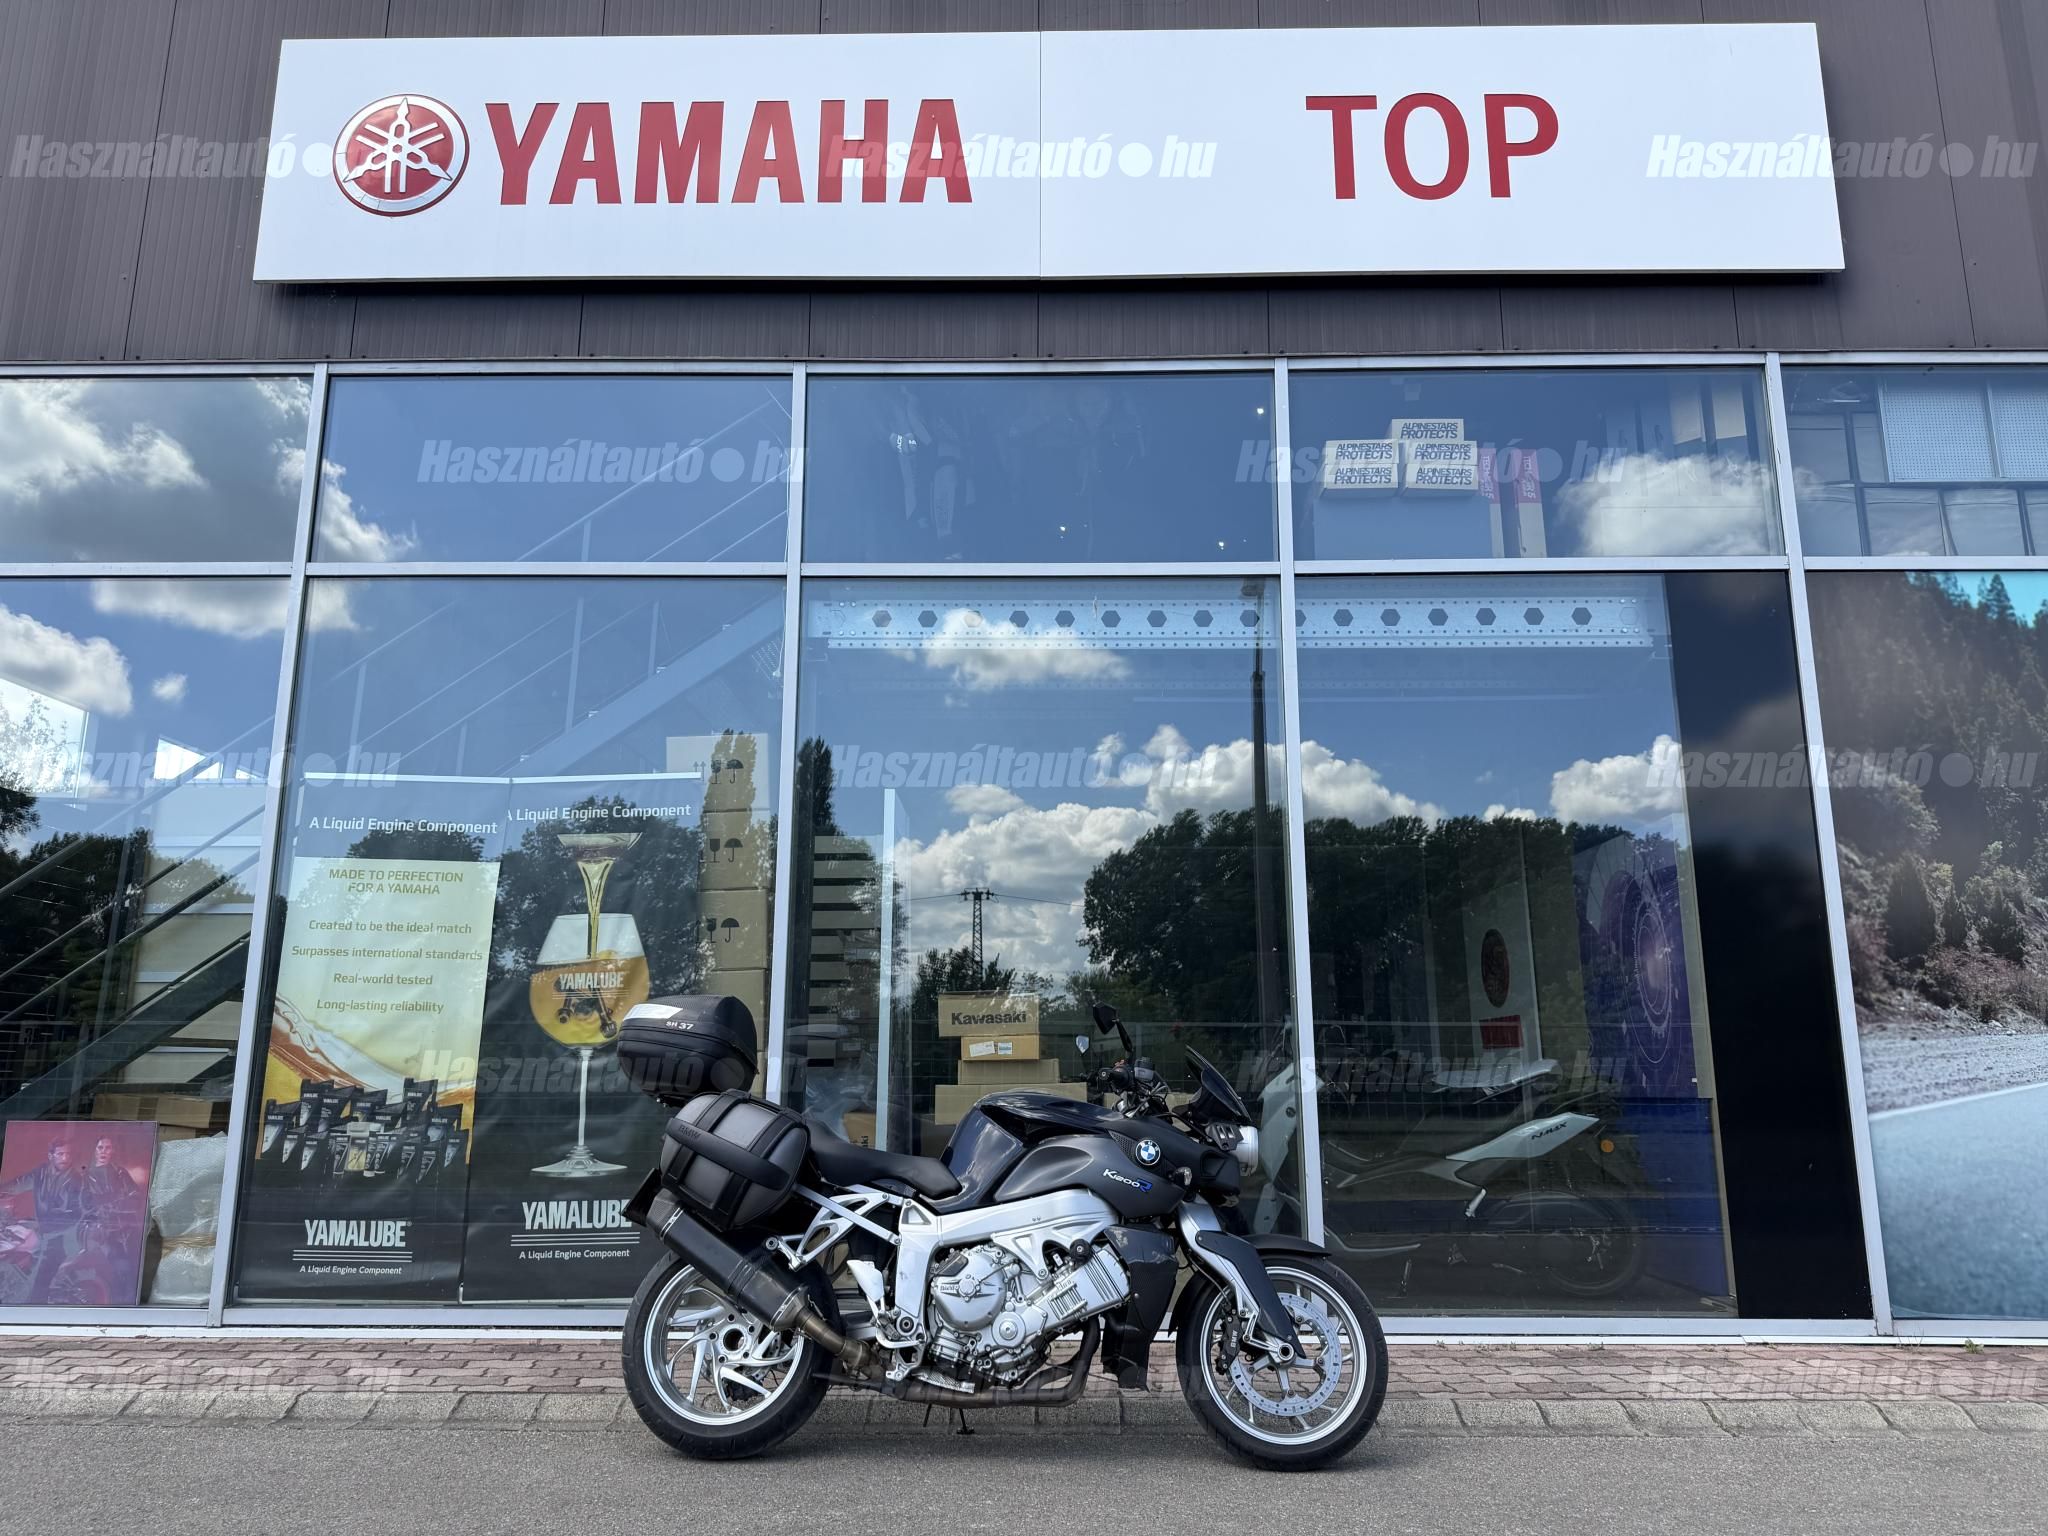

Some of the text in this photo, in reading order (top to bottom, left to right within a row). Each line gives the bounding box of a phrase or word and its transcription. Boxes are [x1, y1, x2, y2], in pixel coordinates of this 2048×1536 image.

[485, 99, 973, 205] YAMAHA
[1306, 92, 1559, 200] TOP
[1402, 422, 1458, 431] ALPINESTARS
[1401, 430, 1458, 439] PROTECTS
[1336, 443, 1392, 451] ALPINESTARS
[1335, 450, 1392, 460] PROTECTS
[1414, 450, 1471, 460] PROTECTS
[1336, 467, 1391, 476] ALPINESTARS
[1417, 467, 1472, 476] ALPINESTARS
[1334, 475, 1391, 484] PROTECTS
[1415, 475, 1472, 485] PROTECTS
[517, 808, 557, 823] Liquid
[562, 806, 608, 822] Engine
[613, 804, 691, 820] Component
[309, 817, 498, 835] A Liquid Engine Component
[329, 869, 463, 882] MADE TO PERFECTION
[348, 882, 440, 894] FOR A YAMAHA
[309, 920, 472, 934] Created to be the ideal match
[292, 946, 483, 960] Surpasses international standards
[334, 973, 433, 985] Real-world tested
[559, 972, 625, 990] YAMALUBE
[317, 1000, 444, 1014] Long-lasting reliability
[951, 1012, 1026, 1025] Kawasaki
[679, 1022, 694, 1030] 37
[522, 1199, 632, 1230] YAMALUBE
[305, 1219, 406, 1247] YAMALUBE
[519, 1249, 630, 1260] A Liquid Engine Component
[308, 1265, 331, 1274] Liquid
[332, 1266, 357, 1275] Engine
[359, 1266, 402, 1276] Component
